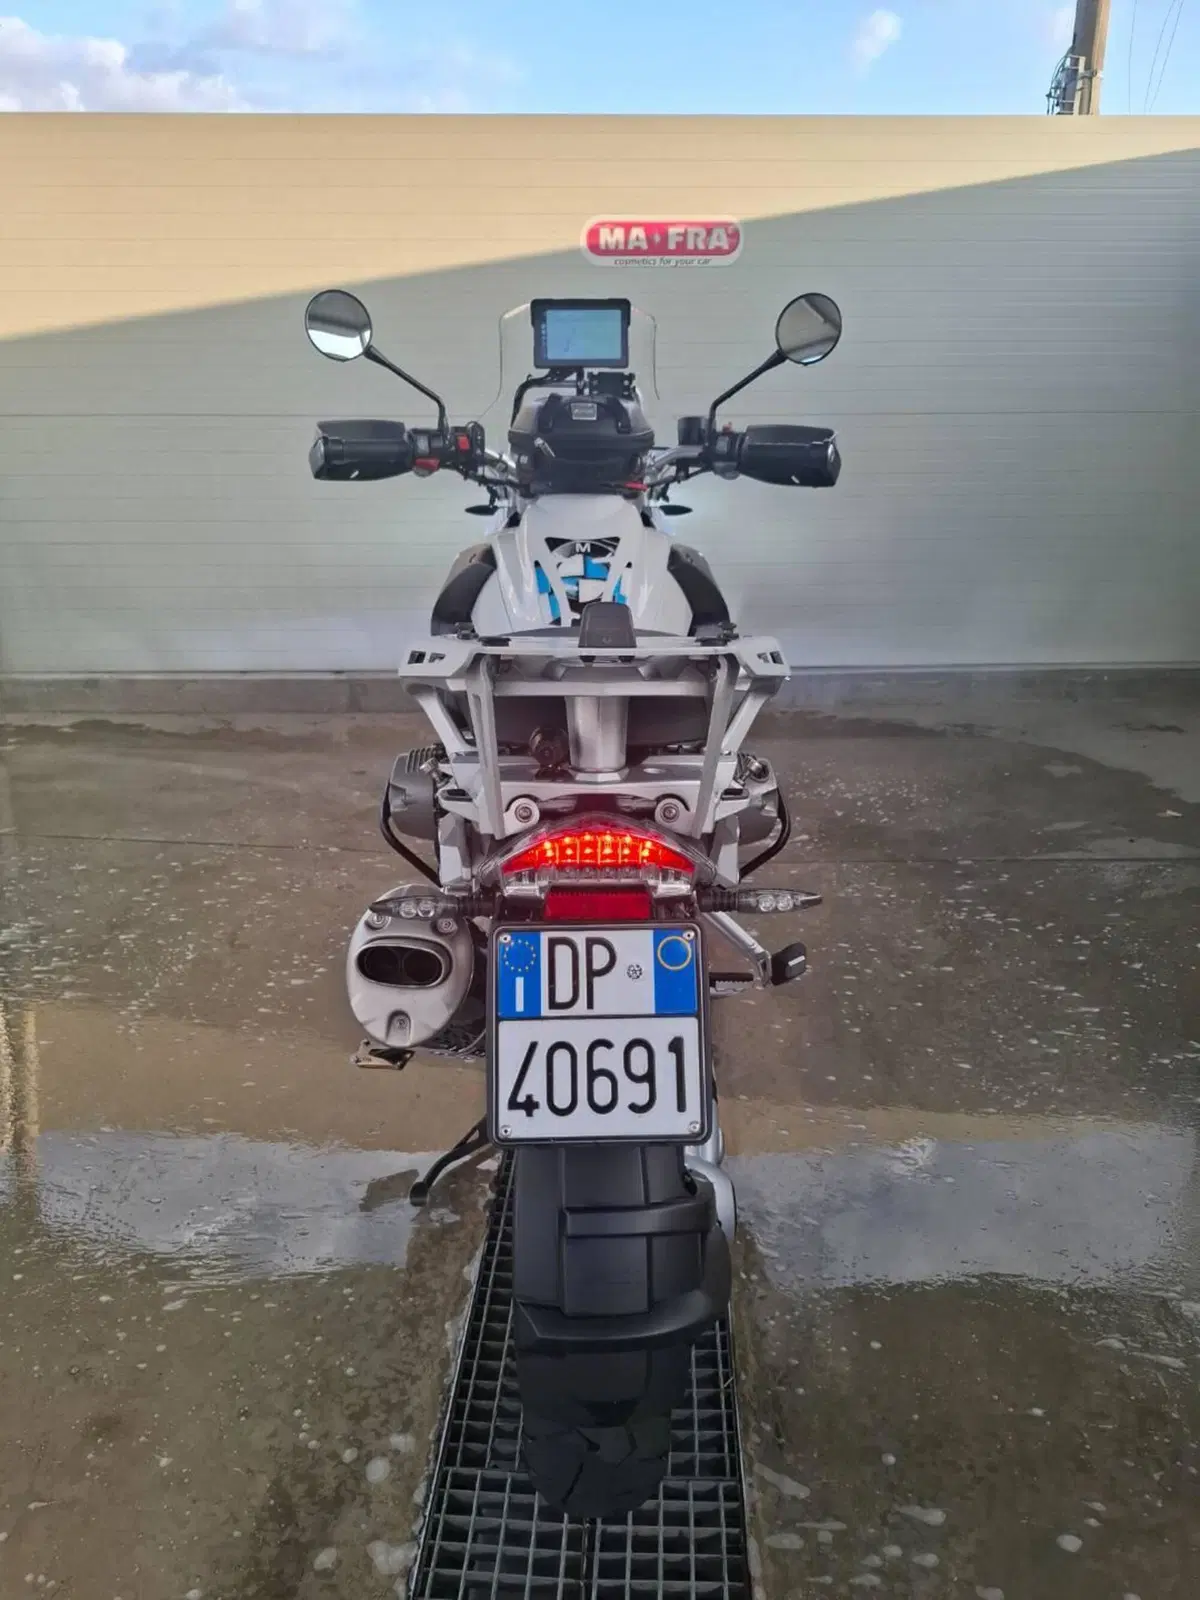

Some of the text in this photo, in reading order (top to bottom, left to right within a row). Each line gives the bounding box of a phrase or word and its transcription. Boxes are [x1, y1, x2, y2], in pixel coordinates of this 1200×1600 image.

[613, 256, 712, 268] cosmetics for your car
[547, 936, 618, 1011] DP
[507, 1035, 688, 1118] 40691
